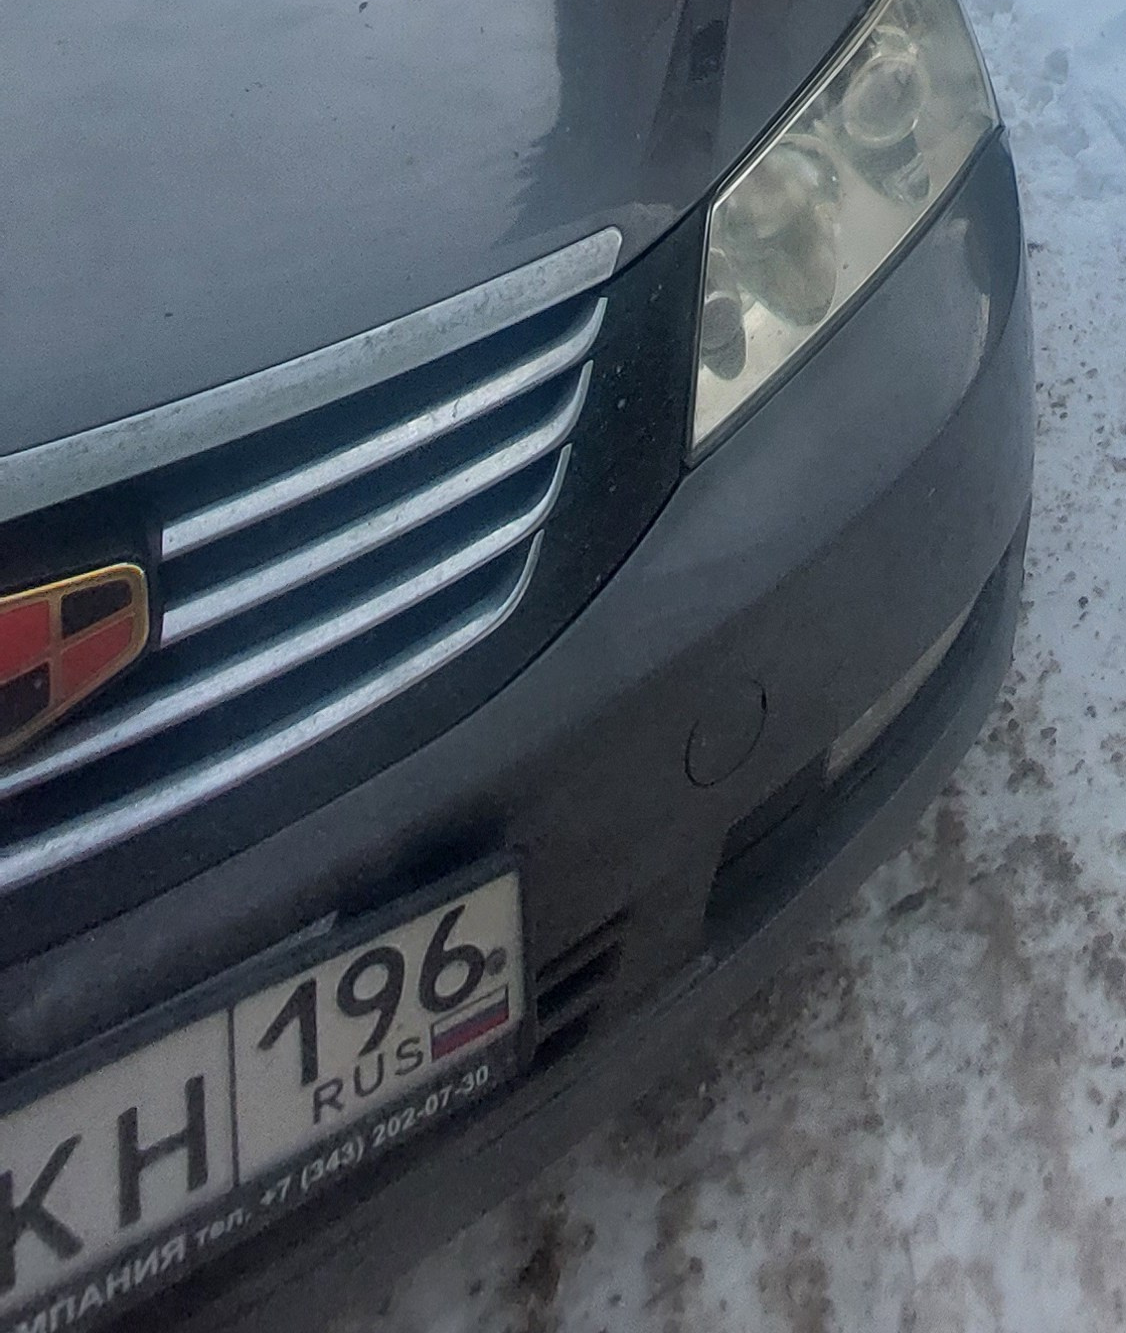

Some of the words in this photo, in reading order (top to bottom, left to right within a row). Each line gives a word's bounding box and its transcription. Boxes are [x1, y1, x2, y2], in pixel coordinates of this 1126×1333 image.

[258, 904, 486, 1085] 196
[260, 1175, 291, 1205] +7
[301, 1136, 365, 1192] (343)
[372, 1065, 489, 1147] 202-07-30
[312, 1036, 424, 1124] RUS
